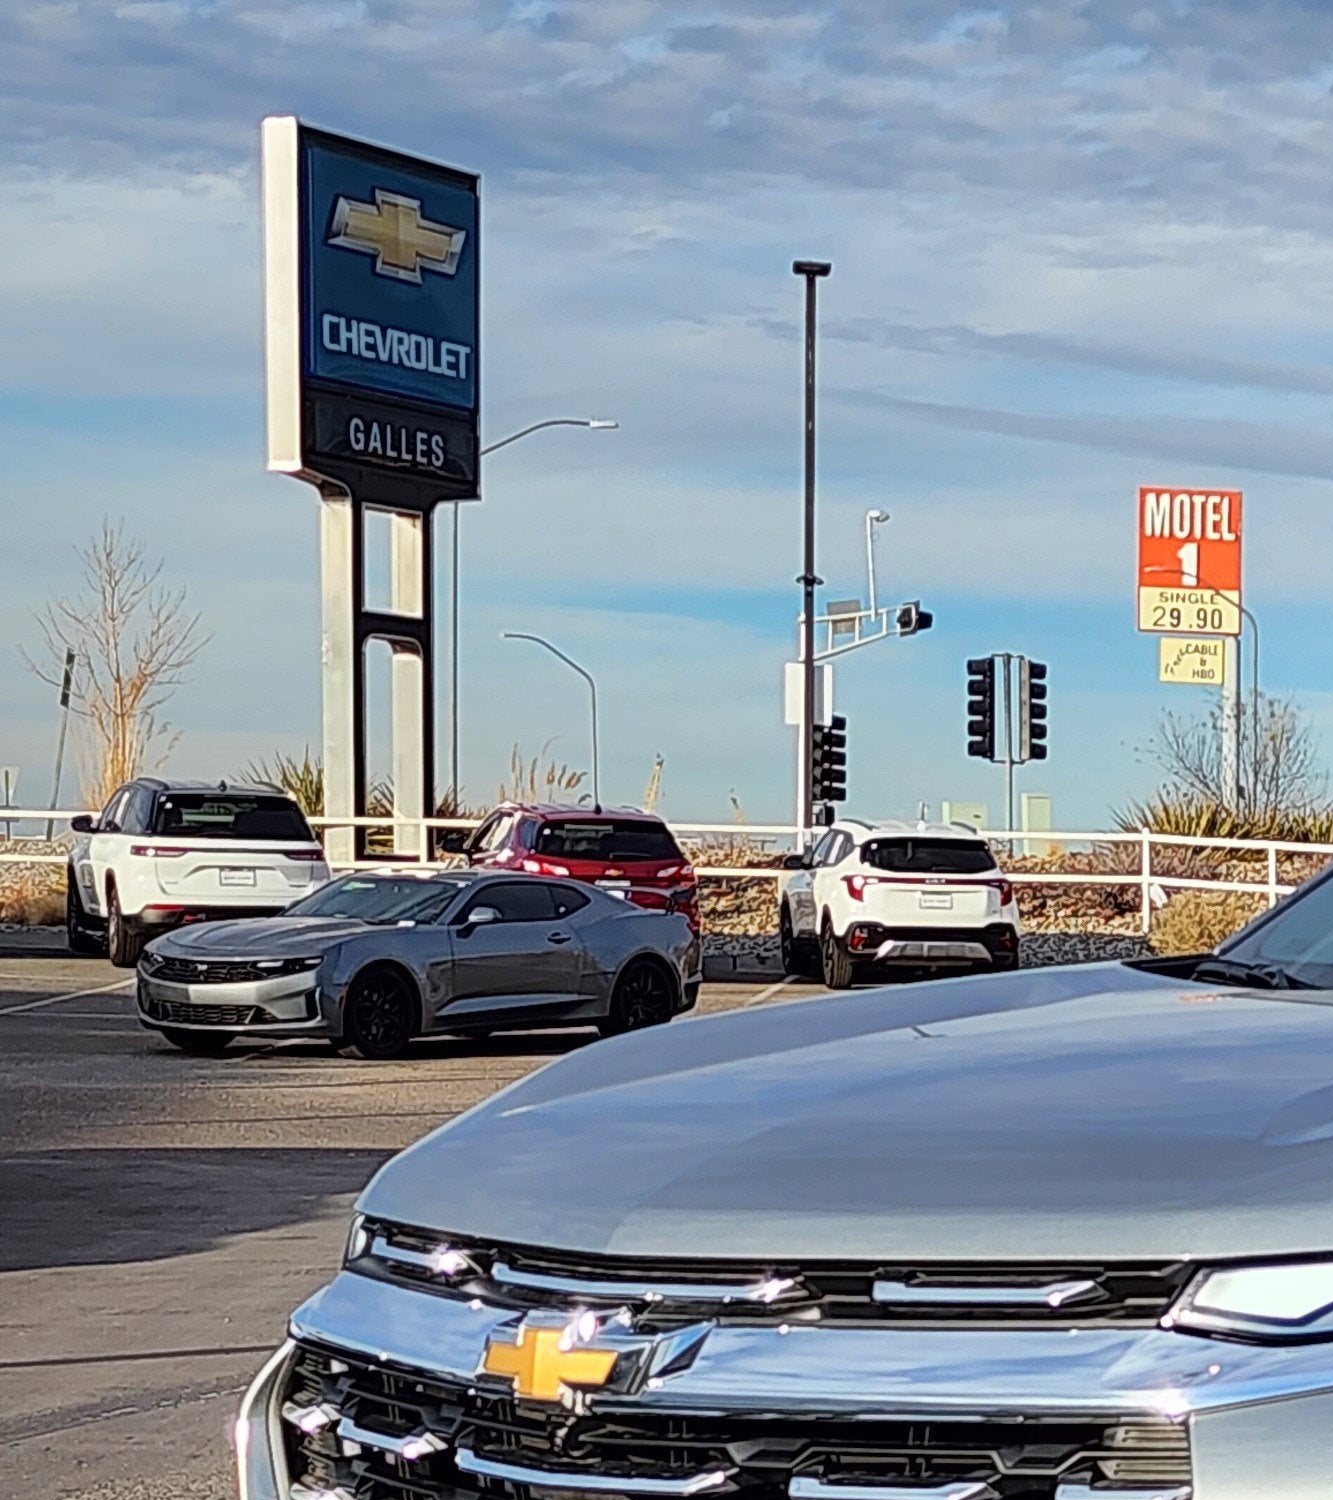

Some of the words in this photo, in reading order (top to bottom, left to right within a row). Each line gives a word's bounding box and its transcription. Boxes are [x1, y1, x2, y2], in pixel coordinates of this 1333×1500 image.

[322, 313, 471, 380] CHEVROLET
[349, 417, 445, 467] GALLES
[1144, 492, 1236, 541] MOTEL
[1176, 542, 1199, 587] 1
[1152, 606, 1223, 630] 29.90
[1159, 591, 1220, 605] SINGLE
